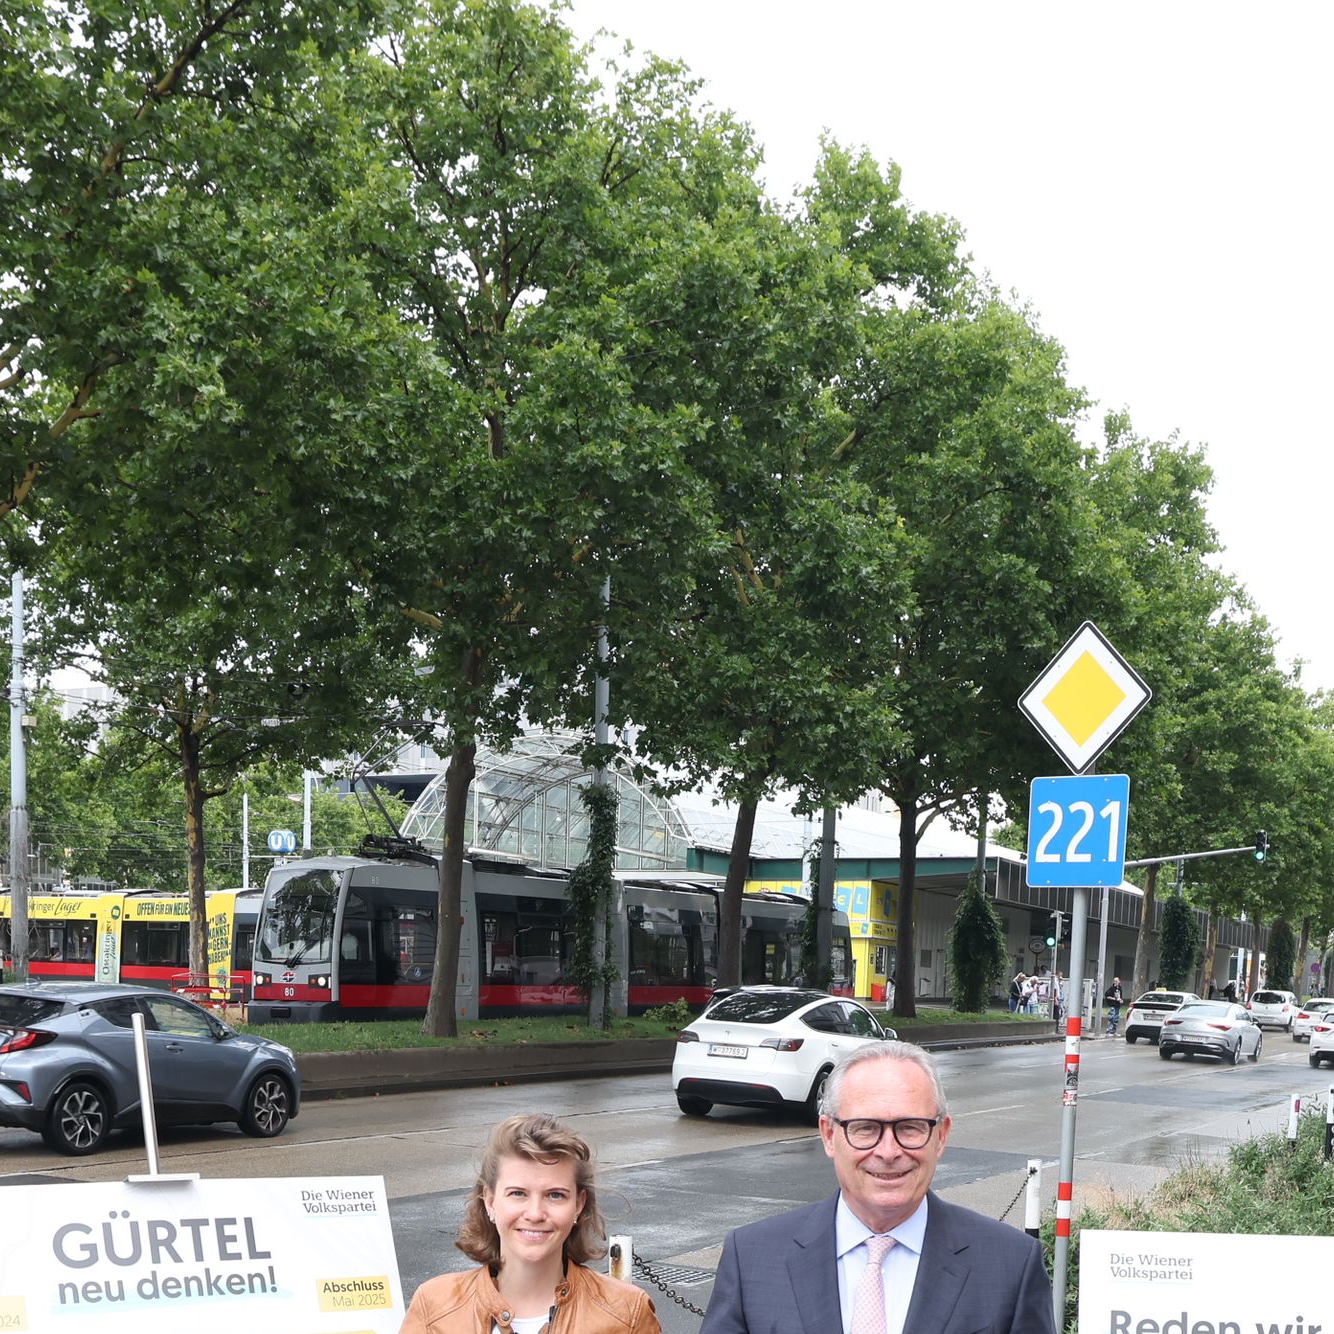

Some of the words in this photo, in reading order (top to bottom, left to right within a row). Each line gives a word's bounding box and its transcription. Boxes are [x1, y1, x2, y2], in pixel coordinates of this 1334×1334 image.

[1035, 800, 1120, 862] 221
[54, 898, 83, 916] Lager
[137, 902, 155, 916] OFFEN
[155, 901, 165, 915] FÜR
[284, 986, 295, 997] 80
[301, 1190, 323, 1202] Die
[328, 1189, 375, 1201] Wiener
[303, 1199, 377, 1215] Volkspartei
[52, 1210, 272, 1270] GÜRTEL
[1110, 1253, 1133, 1266] Die
[1138, 1253, 1193, 1268] Wiener
[1110, 1266, 1193, 1282] Volkspartei
[58, 1276, 126, 1305] neu
[136, 1265, 278, 1303] denken!
[322, 1279, 385, 1294] Abschluss
[332, 1294, 355, 1308] Mai
[358, 1292, 387, 1306] 2025
